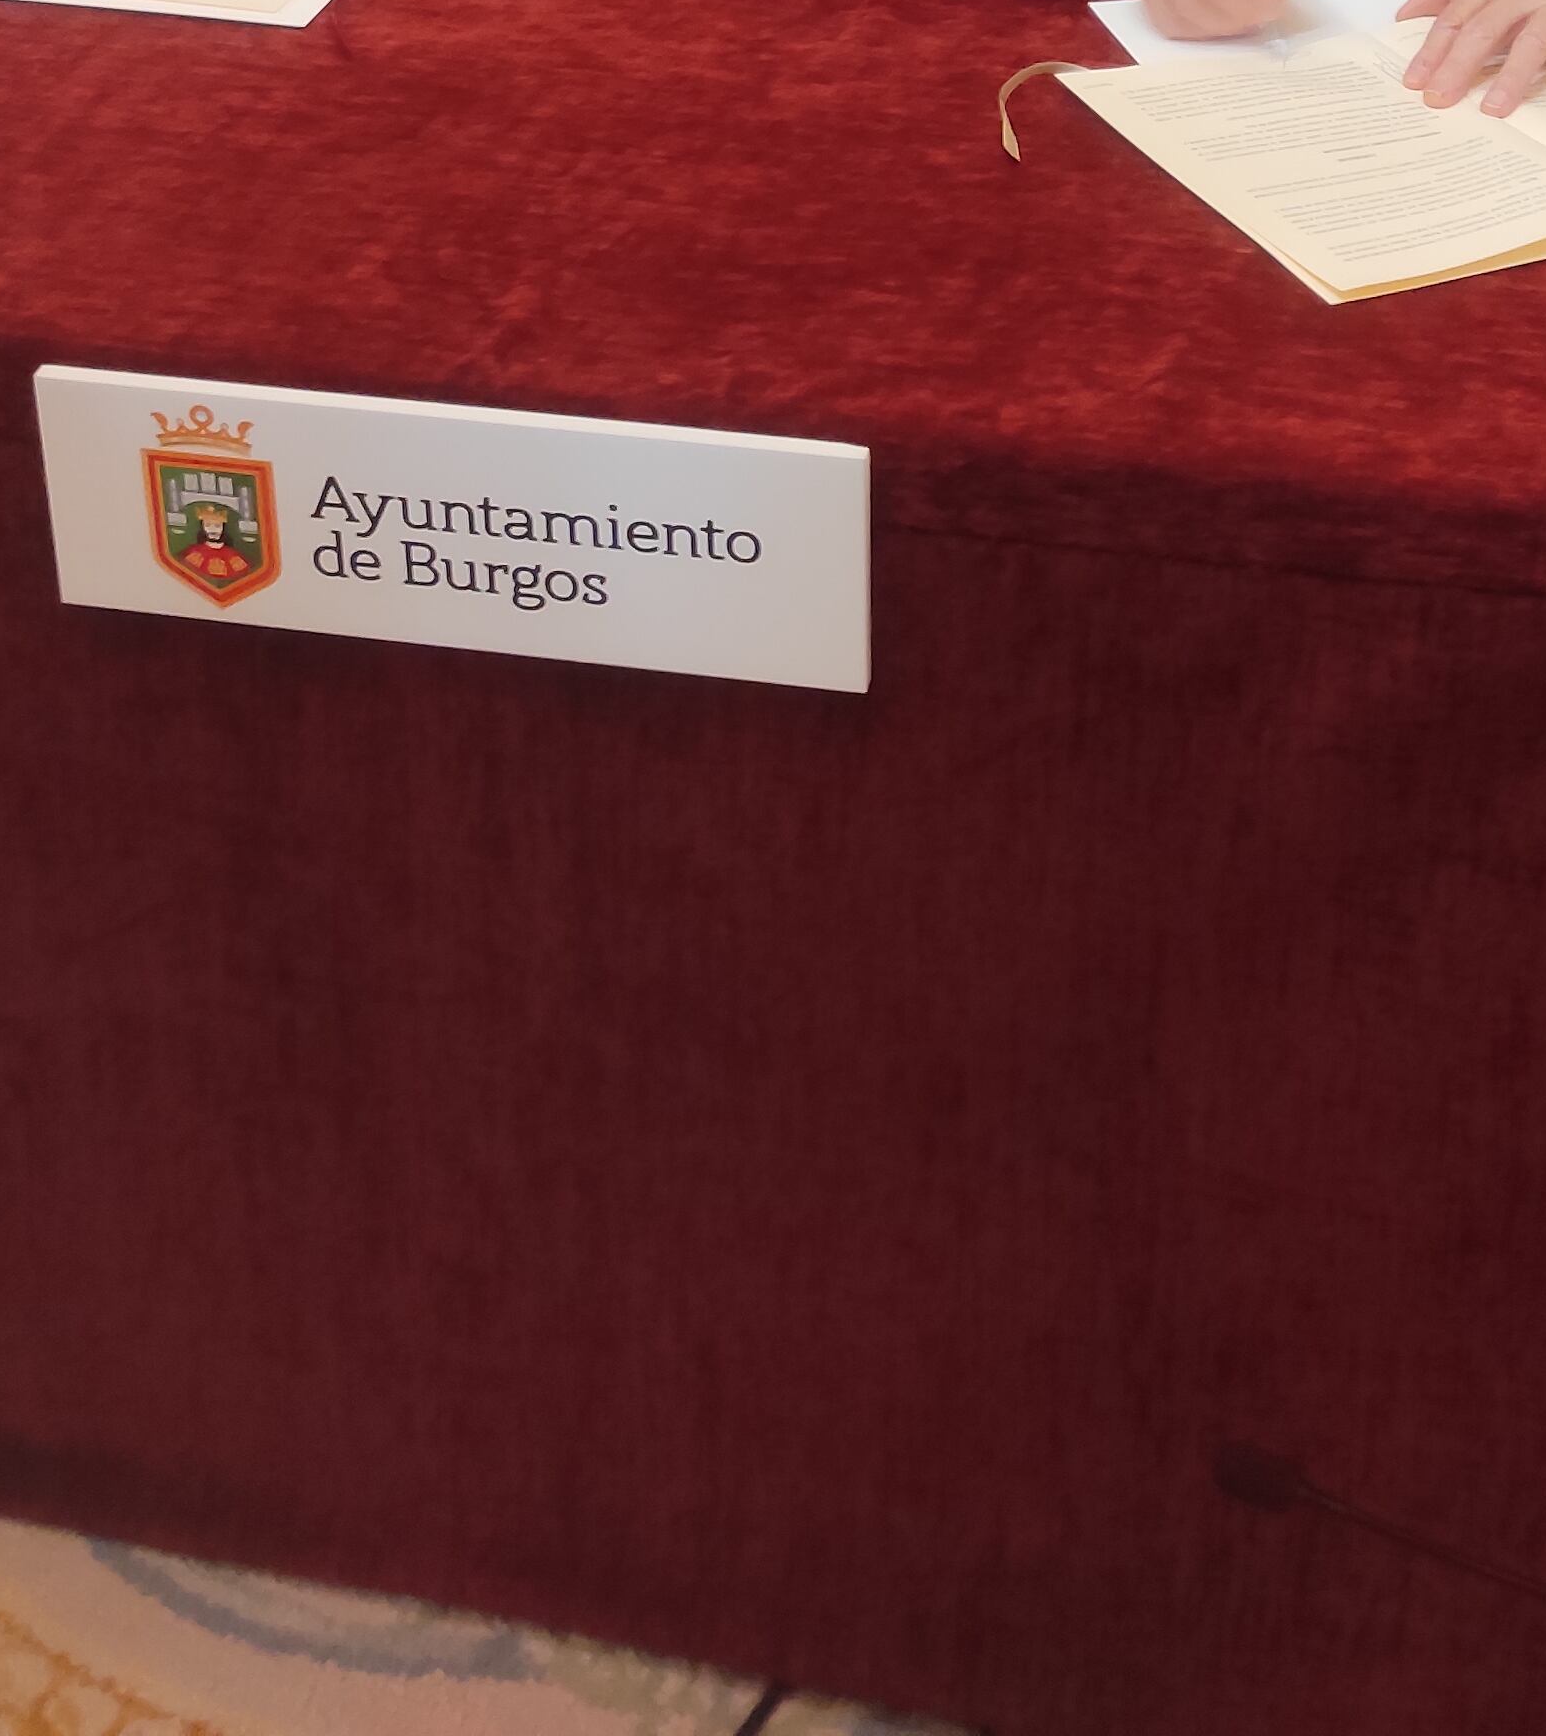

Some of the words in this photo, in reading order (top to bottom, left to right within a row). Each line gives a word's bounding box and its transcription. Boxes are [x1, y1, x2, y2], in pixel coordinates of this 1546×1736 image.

[310, 475, 762, 564] Ayuntamiento
[312, 530, 382, 581] de
[399, 539, 609, 611] Burgos
